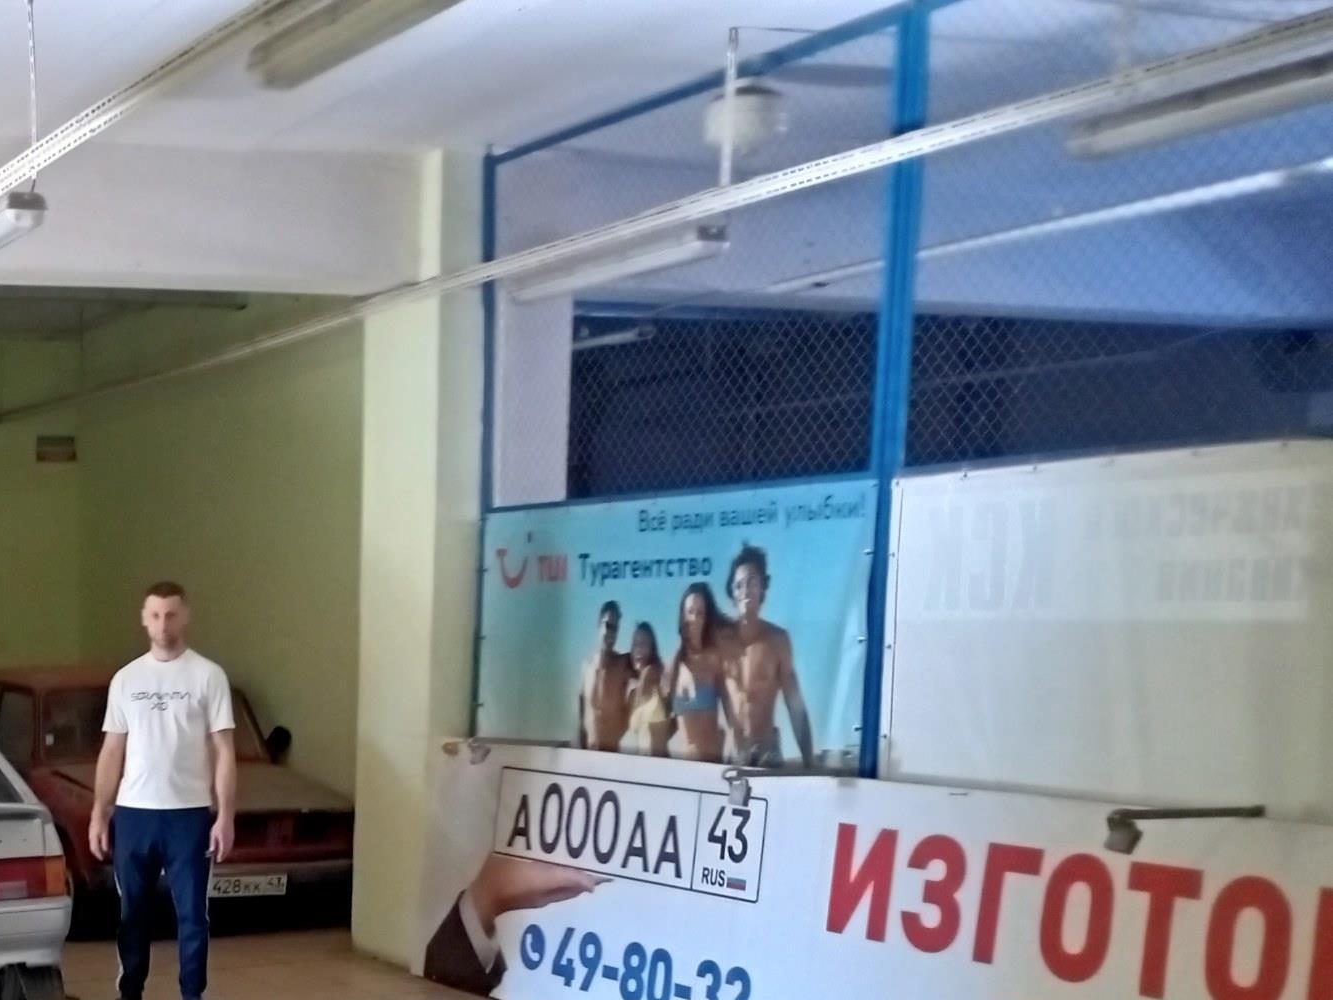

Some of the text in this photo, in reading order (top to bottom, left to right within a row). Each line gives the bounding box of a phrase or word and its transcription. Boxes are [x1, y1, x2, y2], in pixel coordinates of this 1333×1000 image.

[638, 508, 666, 533] Всё
[672, 511, 714, 536] ради
[719, 500, 779, 528] вашей
[578, 552, 713, 587] Турагентство
[707, 805, 752, 864] 43
[212, 878, 261, 895] 428КК
[701, 866, 726, 889] RUS
